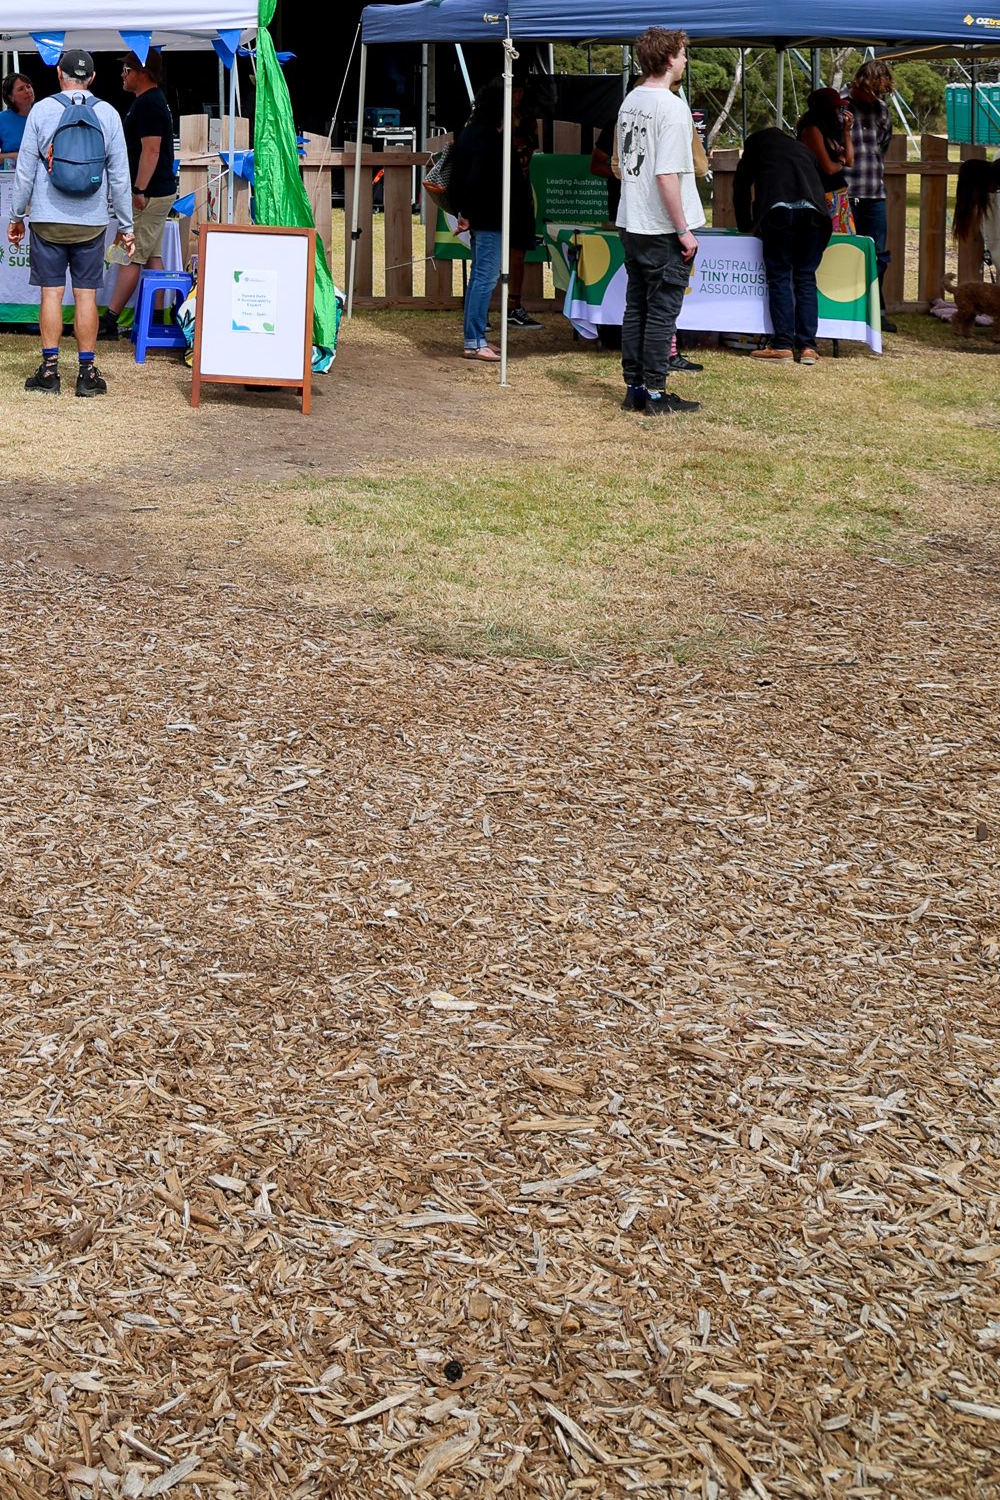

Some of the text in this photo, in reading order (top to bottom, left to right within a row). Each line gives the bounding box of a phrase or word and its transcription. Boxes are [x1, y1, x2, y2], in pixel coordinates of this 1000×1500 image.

[546, 178, 572, 186] Leading
[546, 188, 563, 196] living
[575, 199, 602, 207] housing
[546, 207, 578, 215] education
[701, 270, 765, 284] TINY HOUS
